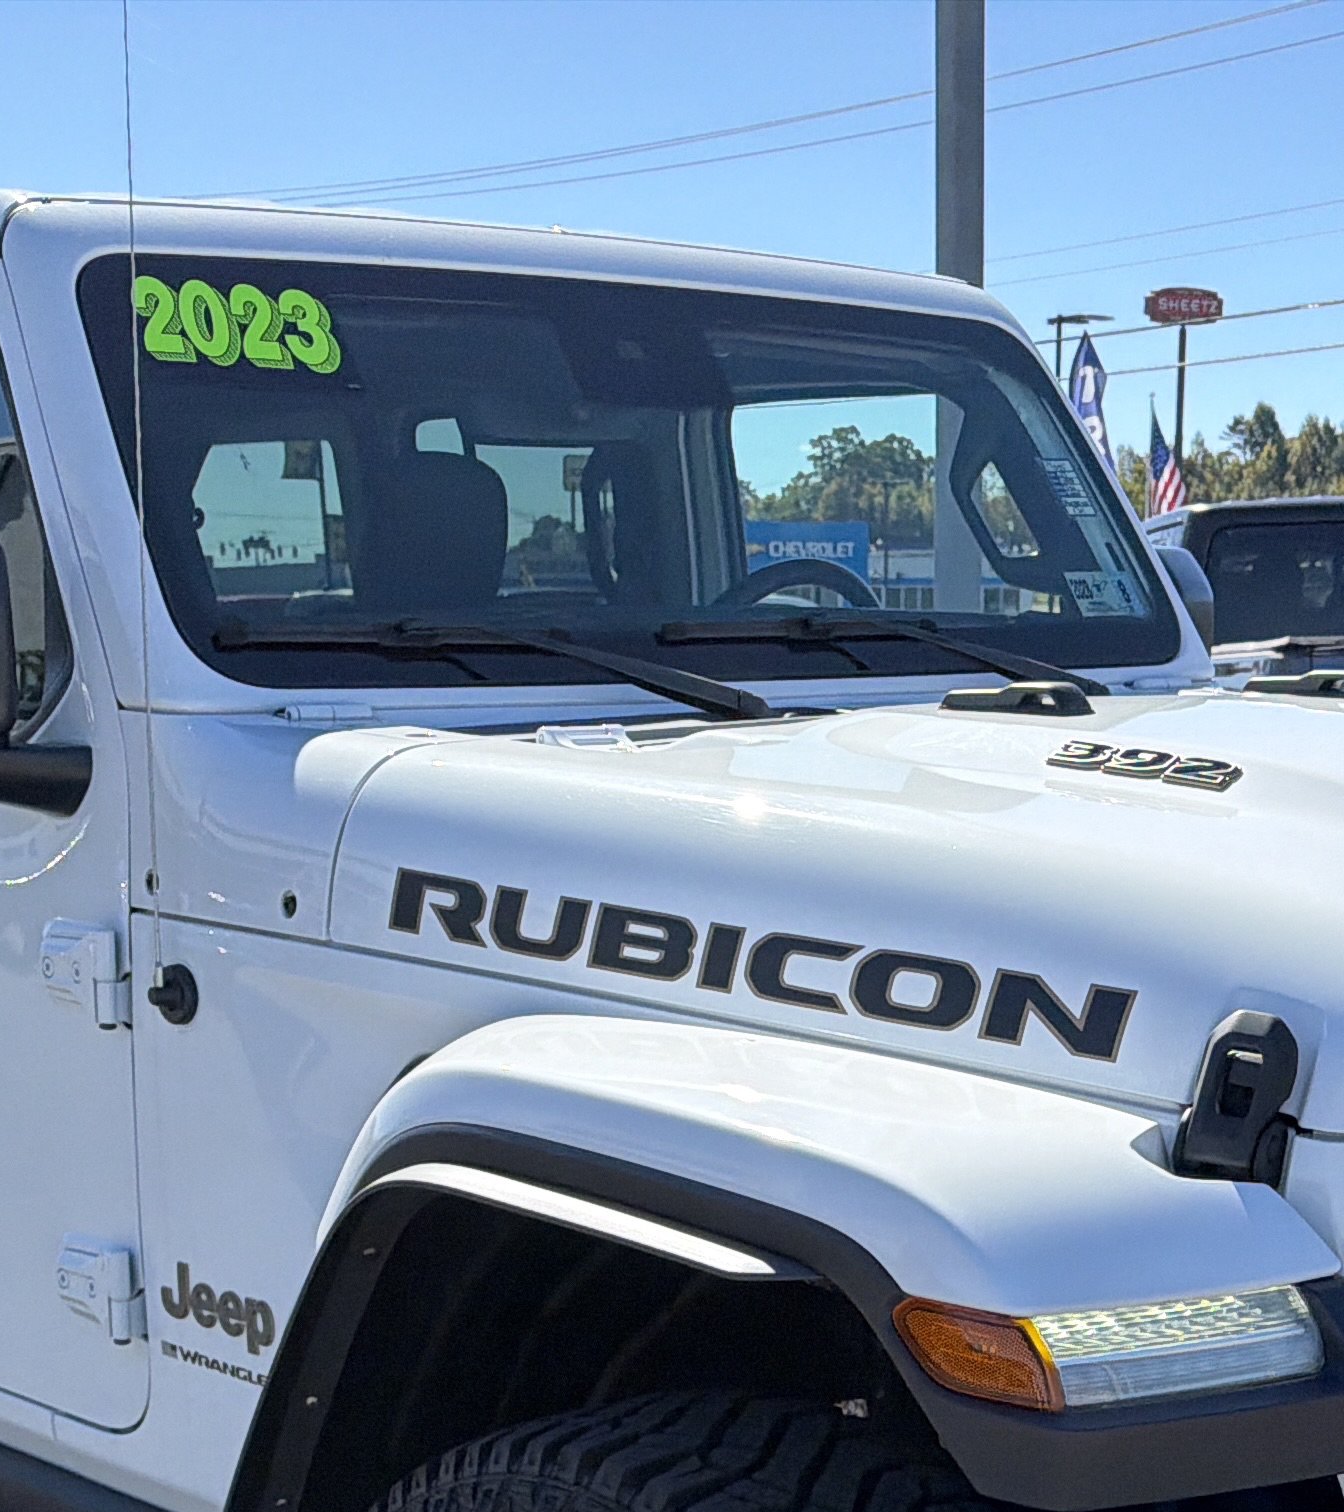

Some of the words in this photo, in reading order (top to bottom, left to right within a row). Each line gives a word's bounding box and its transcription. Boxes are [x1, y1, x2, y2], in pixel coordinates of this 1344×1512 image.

[136, 275, 341, 374] 2023
[1158, 296, 1219, 314] SHEETZ
[768, 540, 855, 558] CHEVROLET
[1046, 740, 1244, 793] 392
[388, 866, 1139, 1064] RUBICON
[160, 1261, 275, 1356] Jeep
